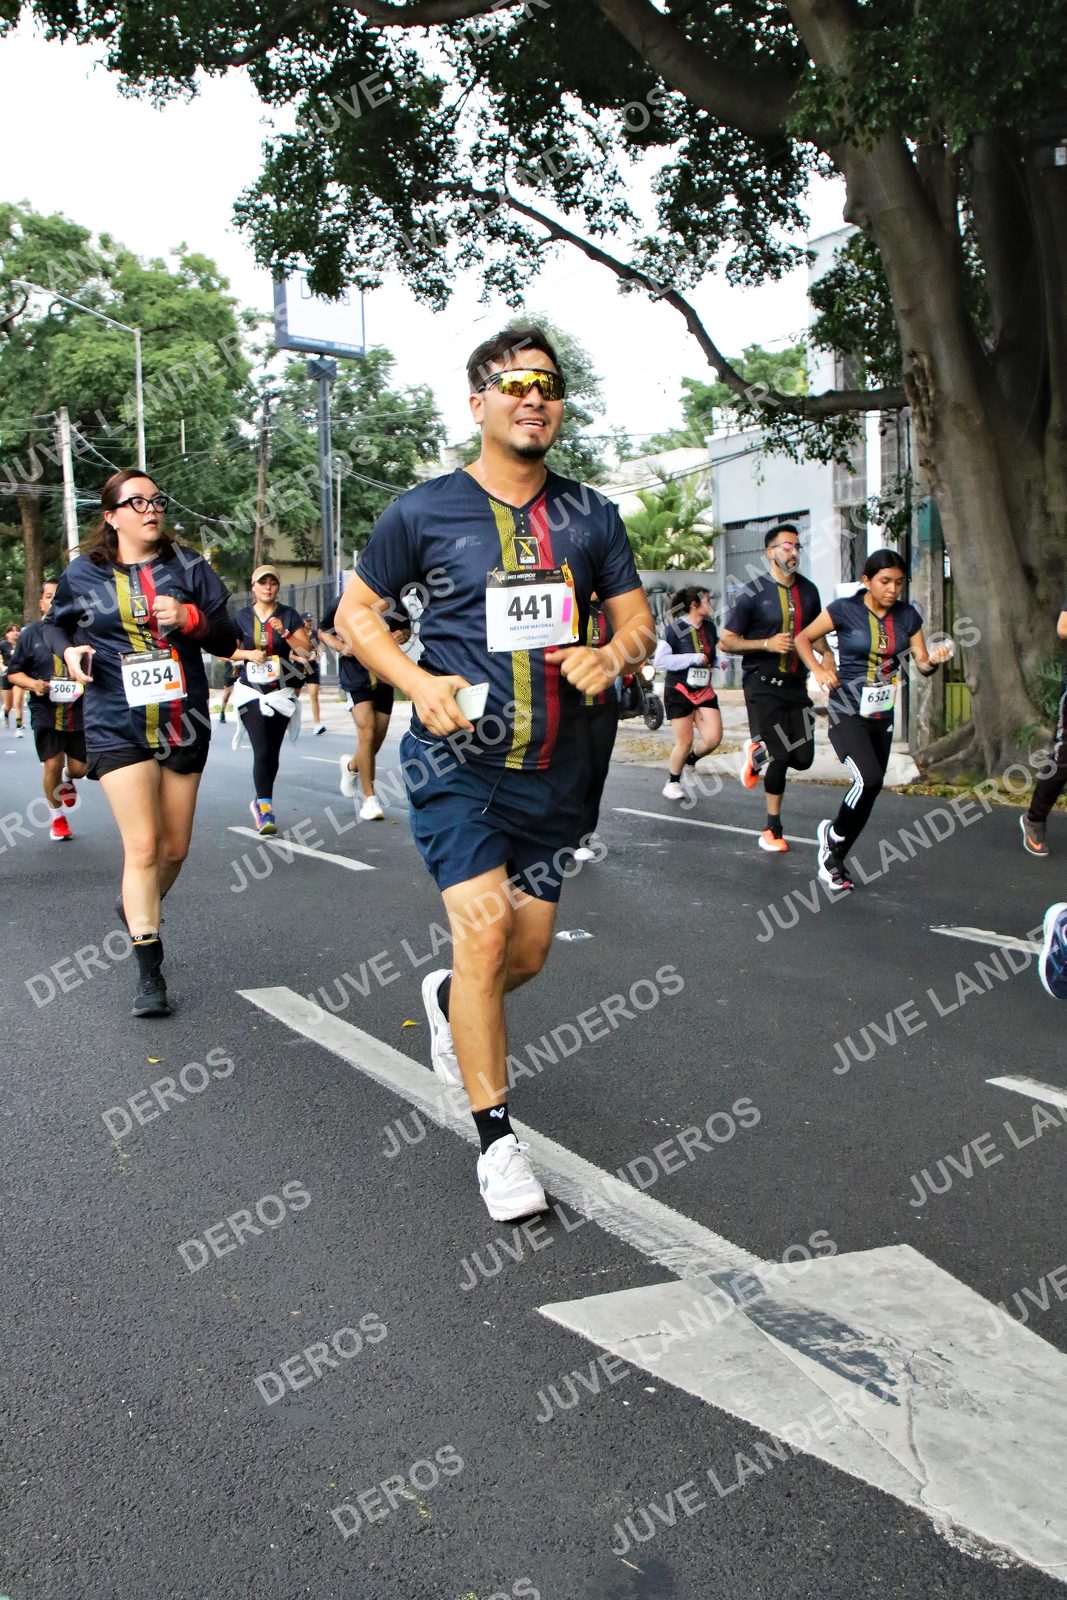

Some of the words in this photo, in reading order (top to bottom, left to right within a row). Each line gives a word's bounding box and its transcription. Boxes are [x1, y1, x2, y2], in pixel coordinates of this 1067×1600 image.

[507, 594, 552, 621] 441
[131, 666, 173, 687] 8254
[54, 684, 76, 693] 5067
[868, 689, 890, 703] 6522
